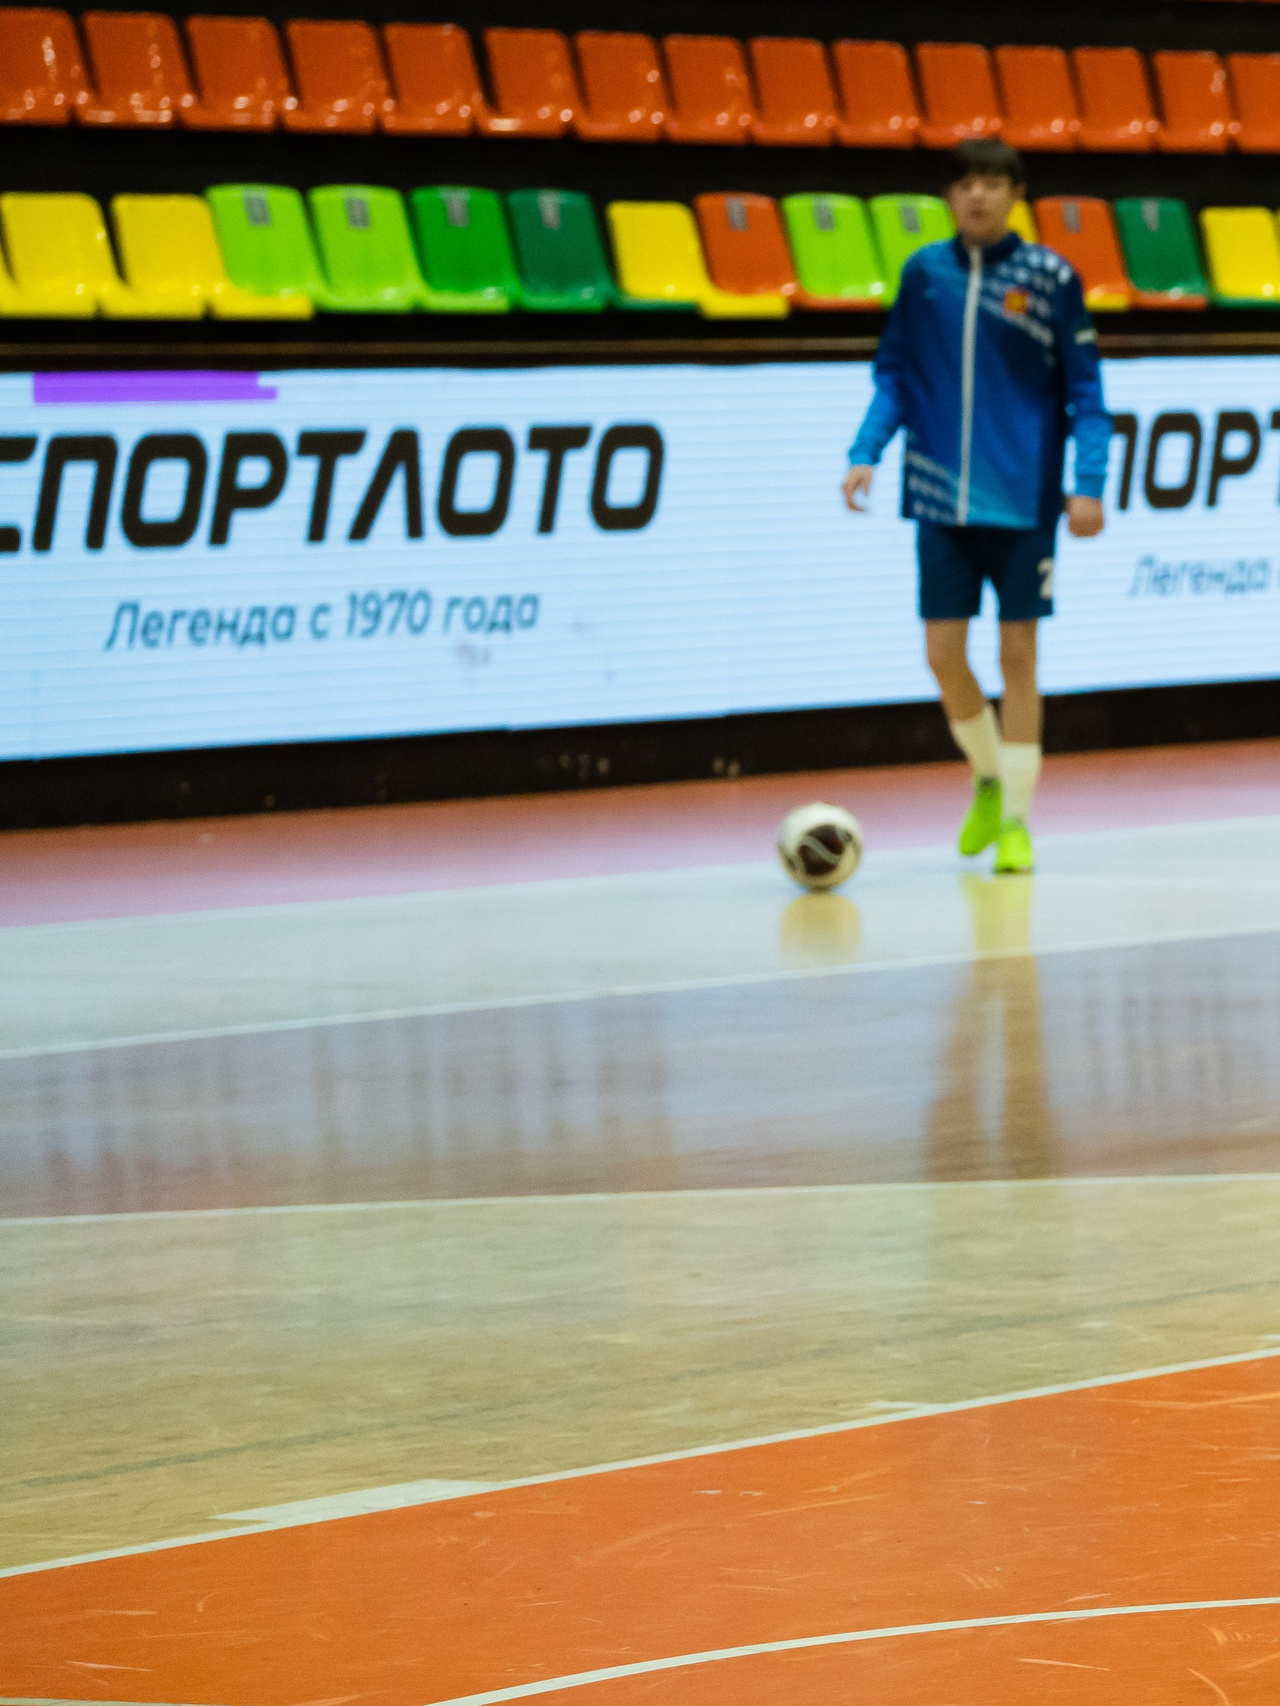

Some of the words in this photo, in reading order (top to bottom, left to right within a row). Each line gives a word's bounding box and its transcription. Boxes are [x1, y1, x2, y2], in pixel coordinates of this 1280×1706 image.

[1129, 553, 1272, 598] Легенда
[103, 600, 297, 653] Легенда
[307, 601, 332, 642] с
[346, 588, 433, 639] 1970
[441, 592, 541, 636] года
